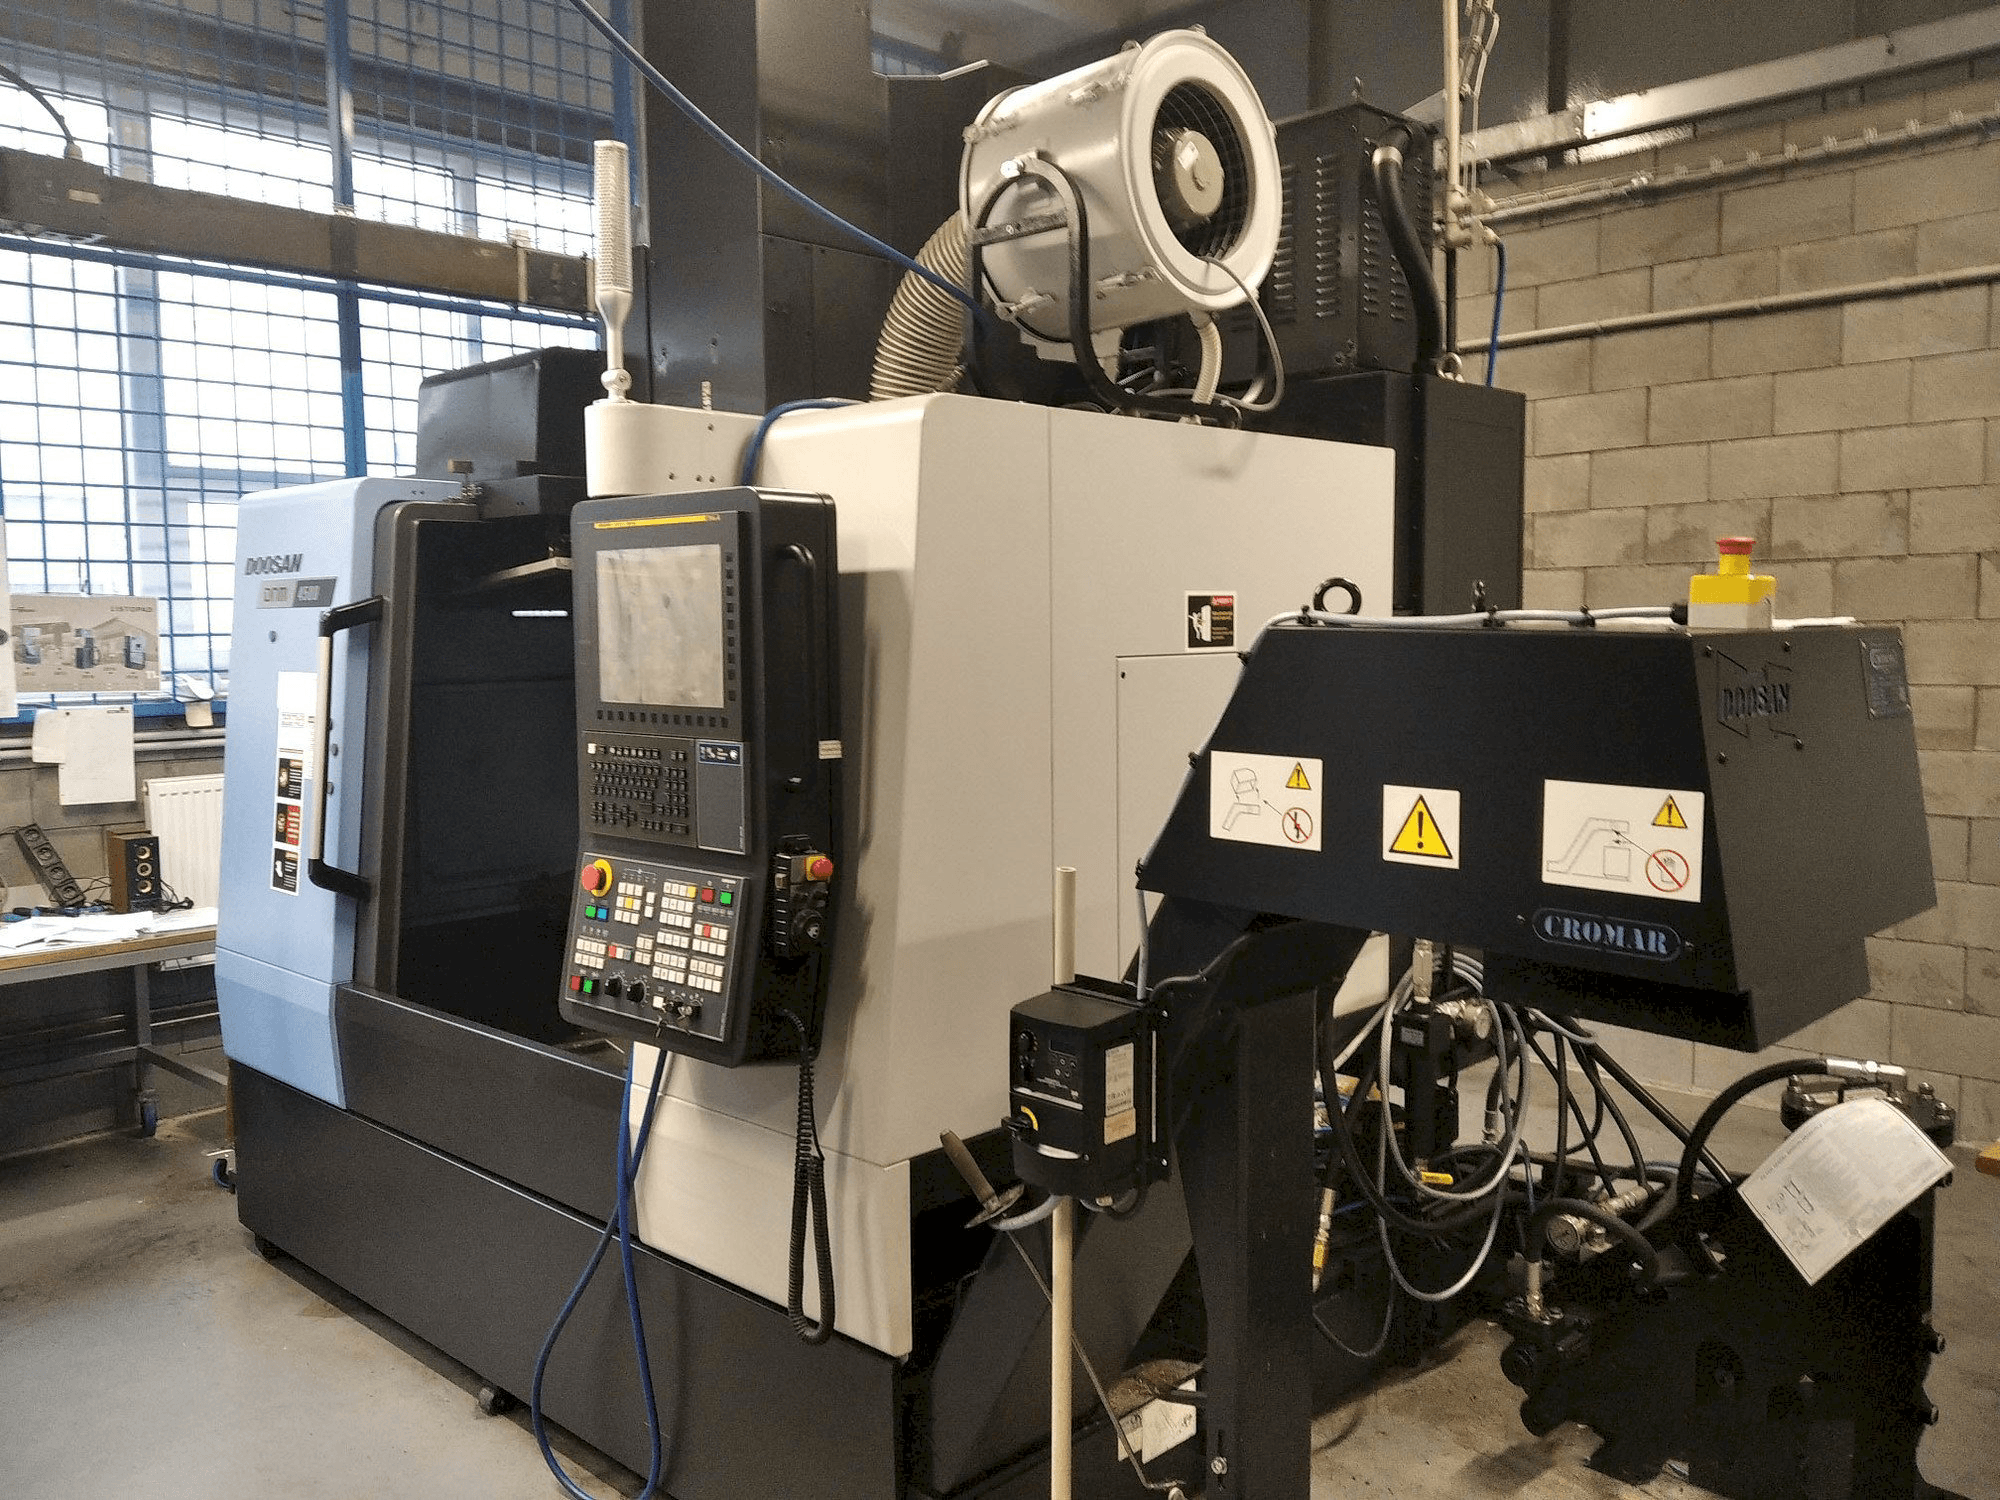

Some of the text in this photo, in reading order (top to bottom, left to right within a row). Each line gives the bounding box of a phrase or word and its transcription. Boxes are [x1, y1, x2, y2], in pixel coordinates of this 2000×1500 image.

[245, 553, 303, 575] DOOSAN
[1719, 683, 1791, 720] DOOSAN
[1543, 914, 1668, 955] CROMAR
